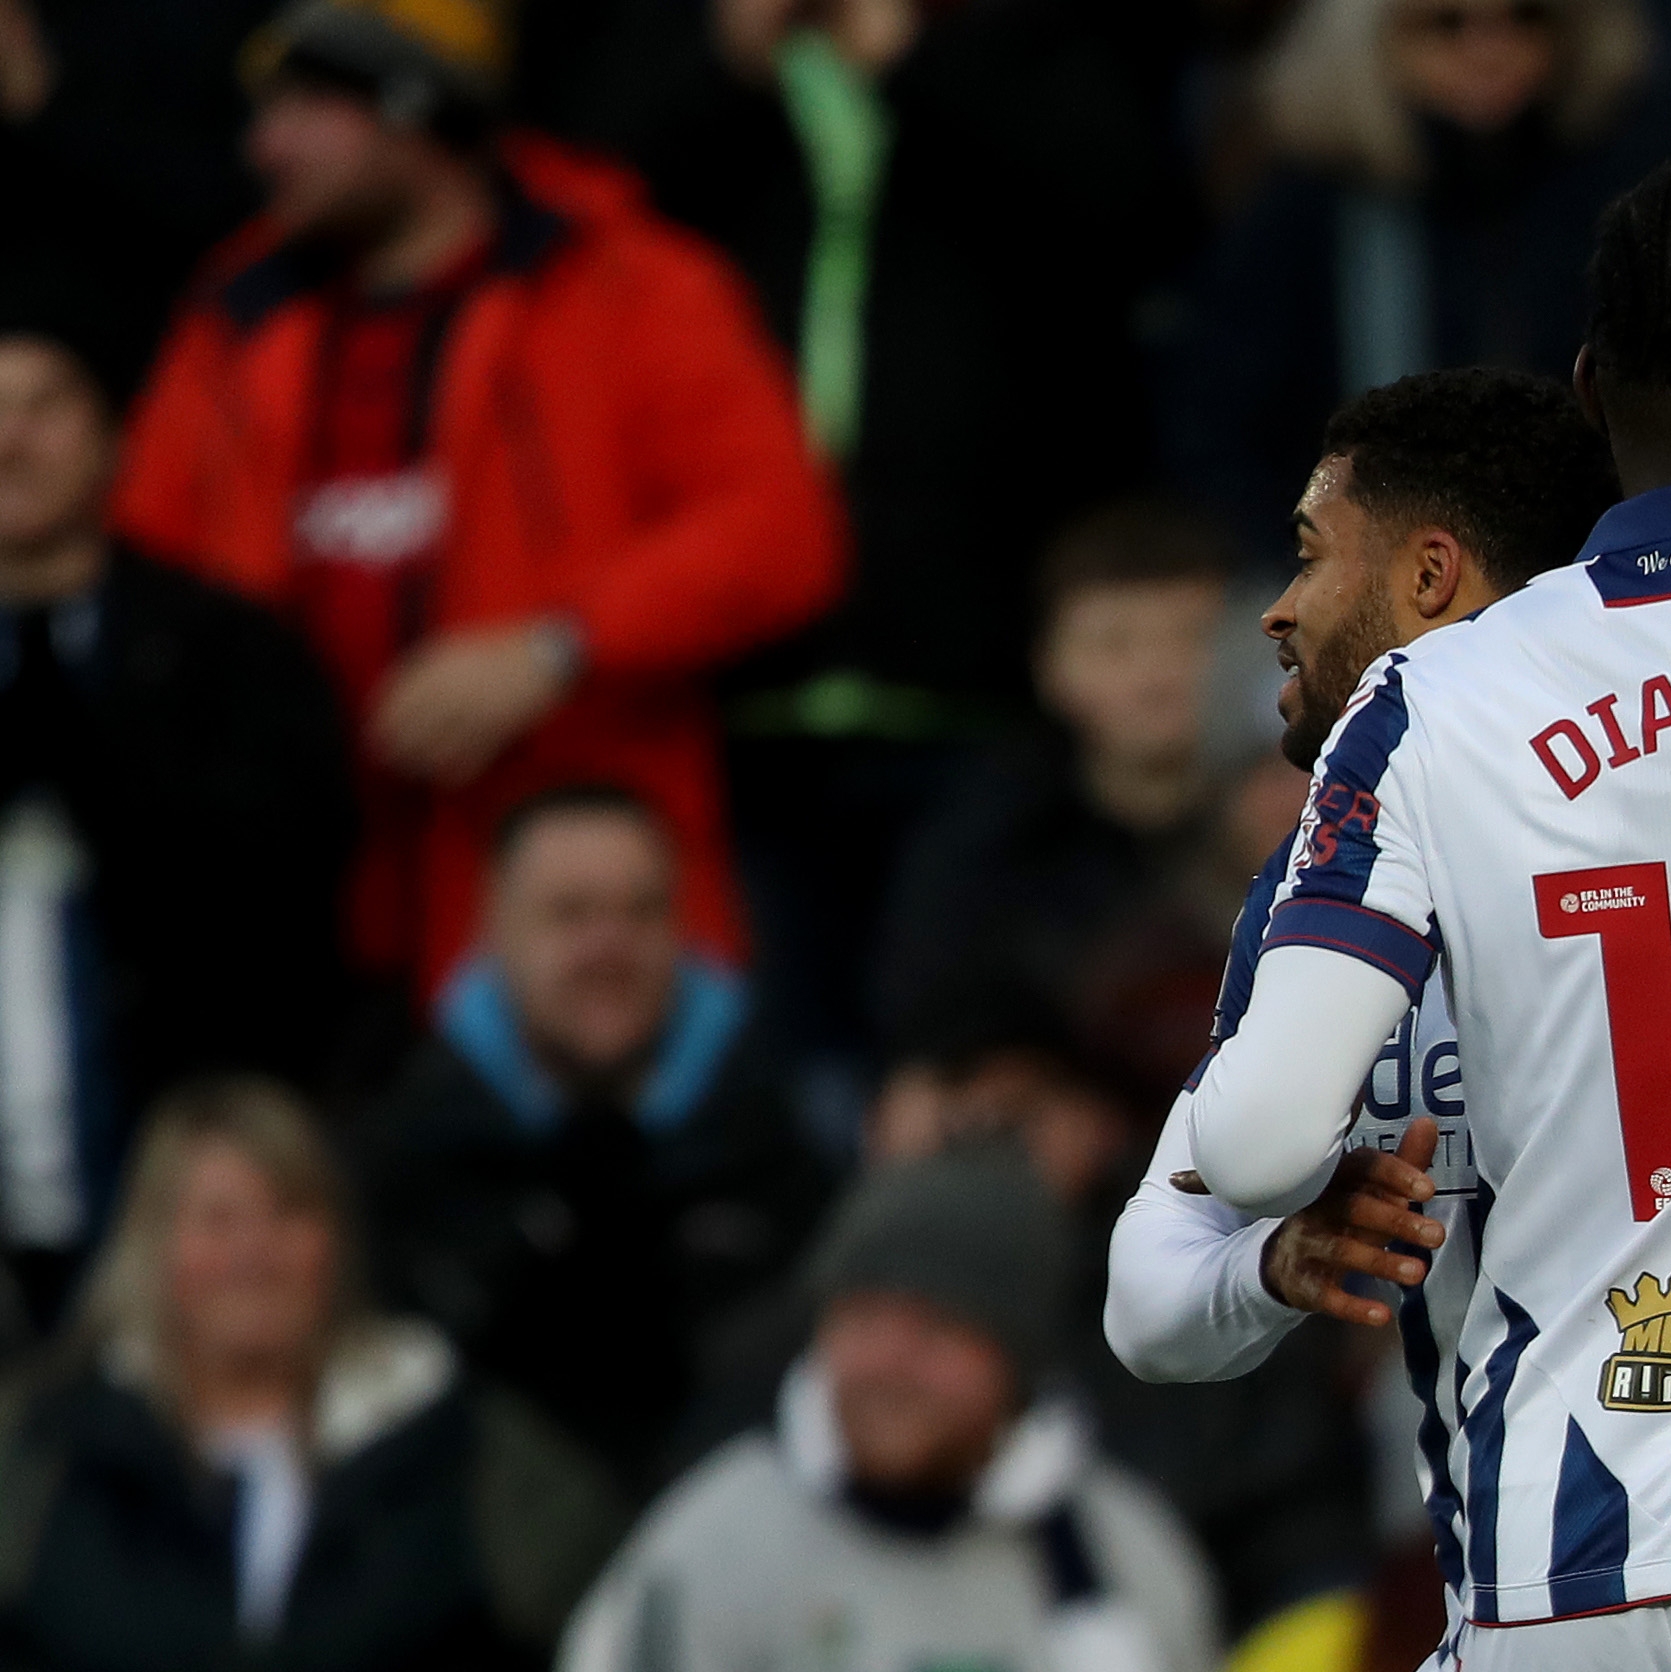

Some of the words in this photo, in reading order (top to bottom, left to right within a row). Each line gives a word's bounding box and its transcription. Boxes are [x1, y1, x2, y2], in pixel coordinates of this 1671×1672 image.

[1637, 551, 1667, 575] We
[1580, 890, 1599, 902] EFL
[1600, 888, 1613, 900] IN
[1614, 886, 1634, 898] THE
[1581, 896, 1646, 913] COMMUNITY
